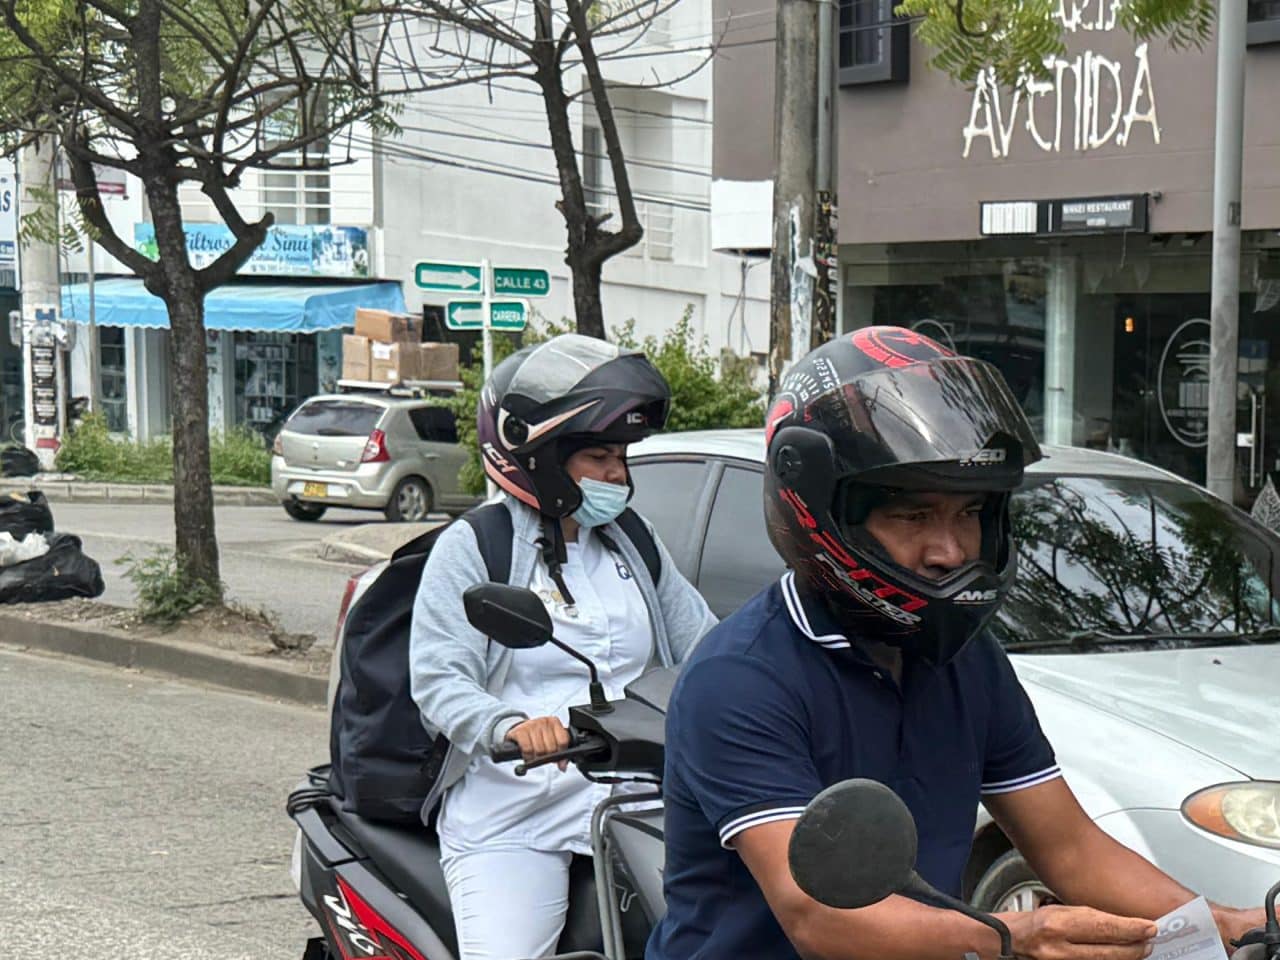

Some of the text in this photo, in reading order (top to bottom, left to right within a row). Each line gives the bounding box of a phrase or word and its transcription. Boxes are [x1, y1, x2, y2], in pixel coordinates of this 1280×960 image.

[963, 42, 1161, 158] AVENIDA
[1087, 200, 1131, 213] RESTAURANT
[496, 277, 546, 289] CALLE 43
